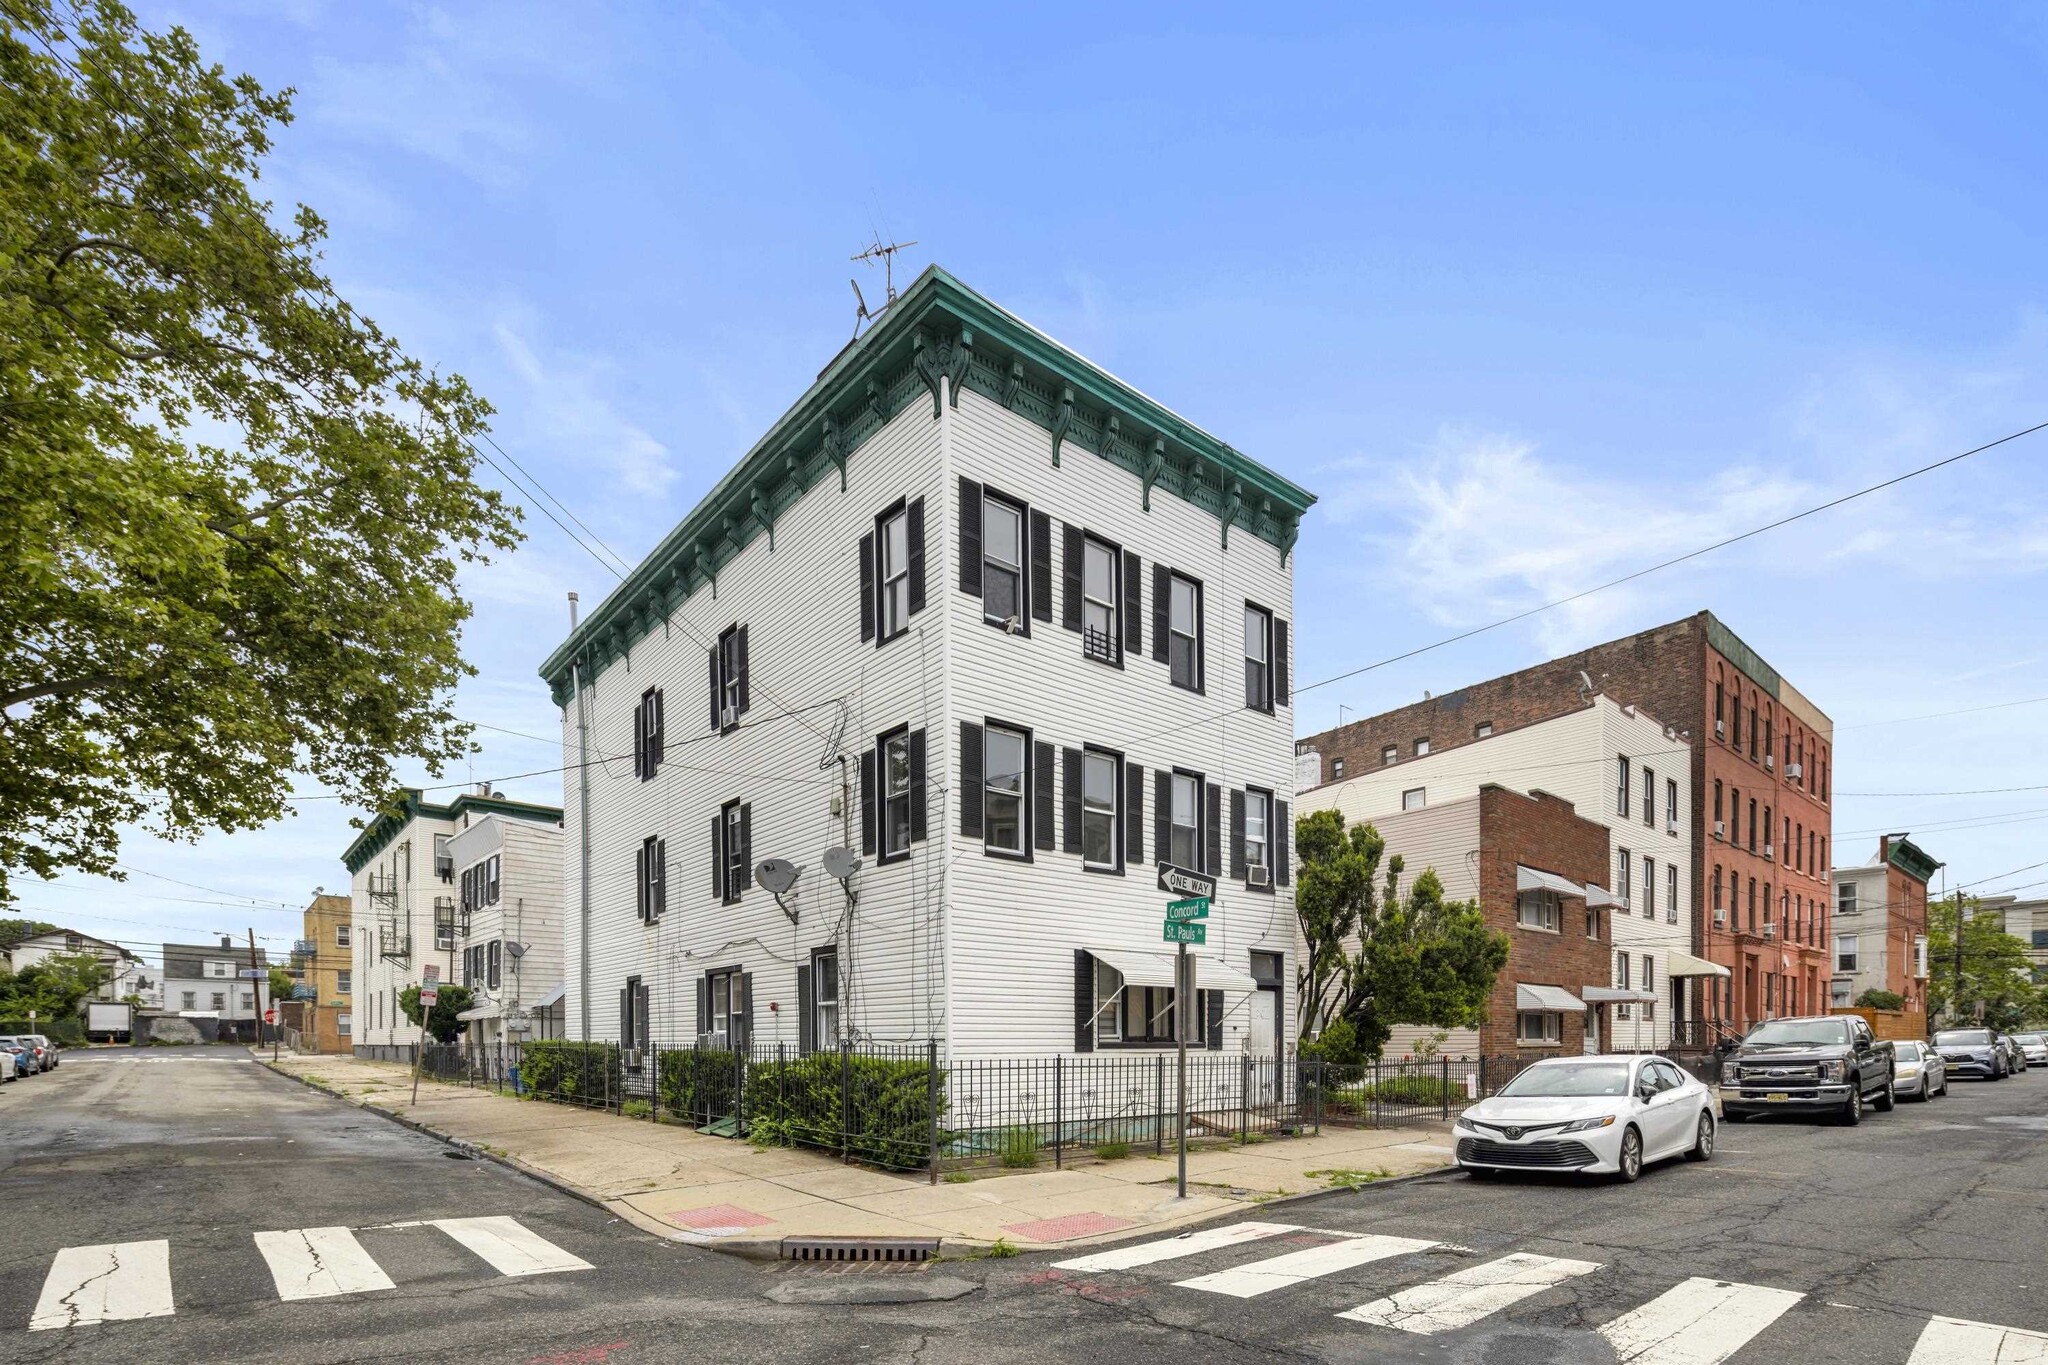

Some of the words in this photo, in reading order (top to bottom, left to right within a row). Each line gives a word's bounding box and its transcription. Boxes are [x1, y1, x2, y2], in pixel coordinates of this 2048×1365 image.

[1170, 874, 1187, 889] ONE
[1191, 880, 1209, 894] WAY
[1169, 901, 1198, 918] Concord
[1166, 925, 1176, 939] St.
[1178, 926, 1195, 940] Pauls
